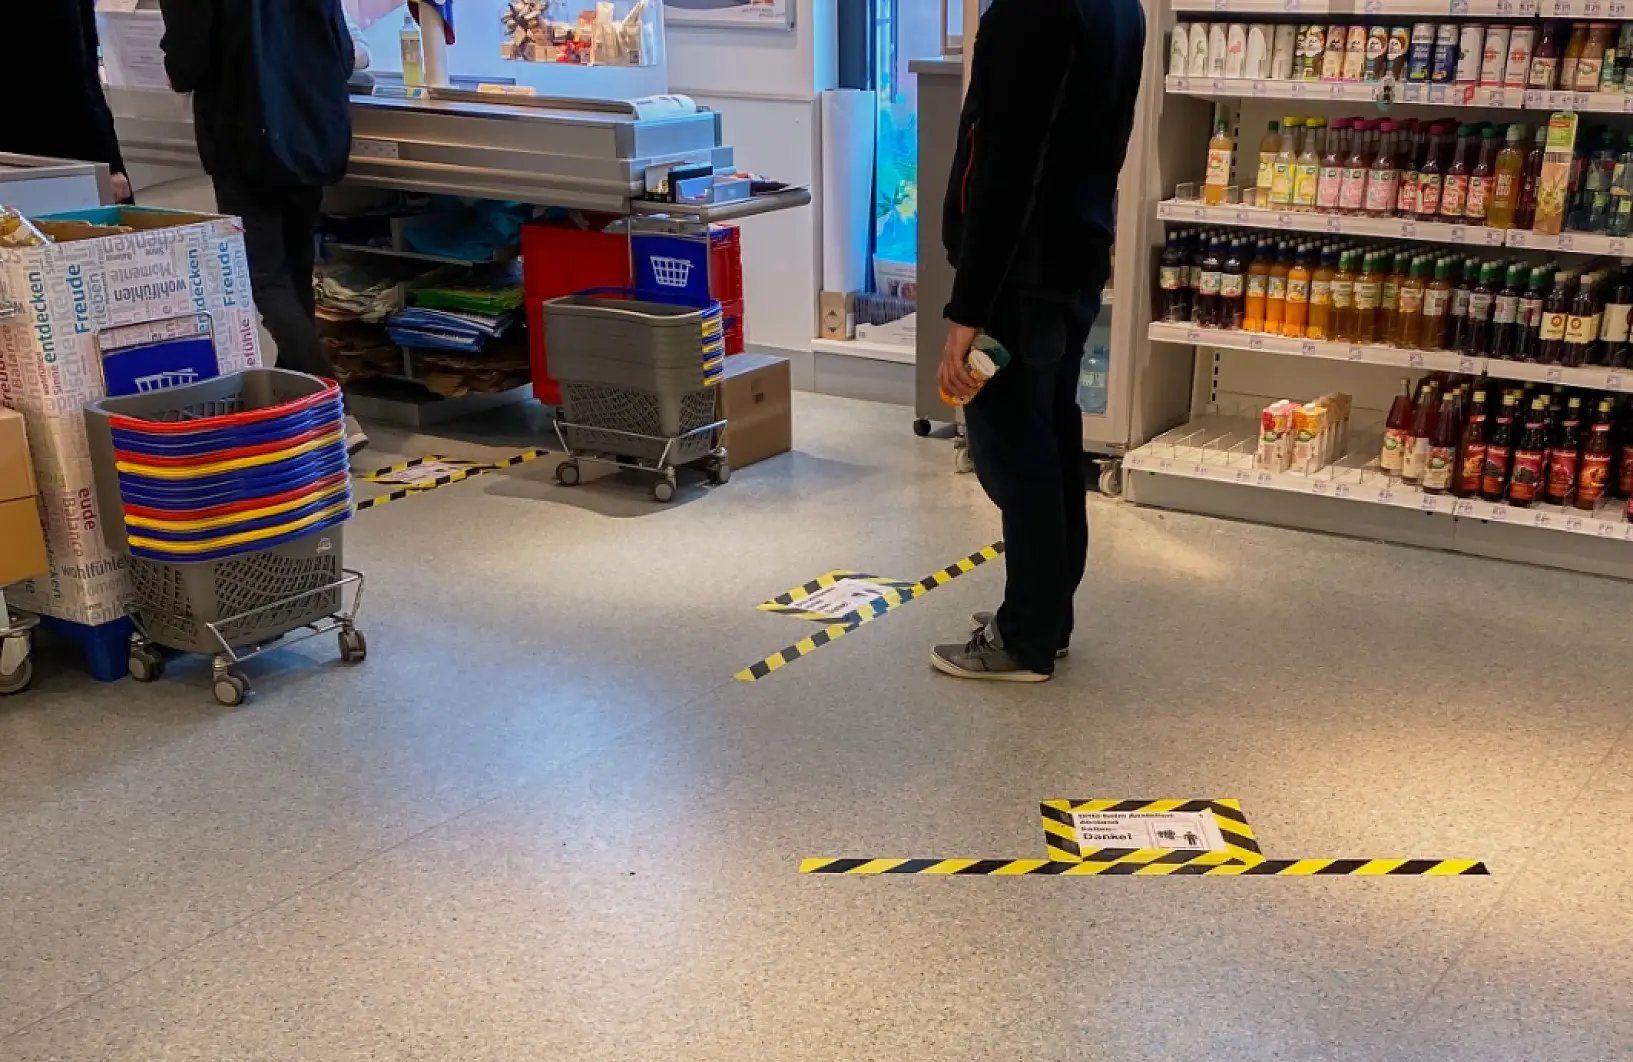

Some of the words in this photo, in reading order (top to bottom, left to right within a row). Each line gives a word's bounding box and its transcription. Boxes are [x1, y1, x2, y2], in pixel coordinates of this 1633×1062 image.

[66, 264, 90, 334] Freude
[88, 273, 108, 326] rleben
[111, 262, 173, 283] Momente
[113, 280, 187, 302] wohlfühlen
[188, 248, 209, 332] entdecken
[218, 242, 236, 306] Freude
[28, 271, 58, 364] entdecken
[62, 496, 84, 558] Balance
[61, 556, 125, 580] wohlfühle
[1083, 832, 1133, 841] Danke!
